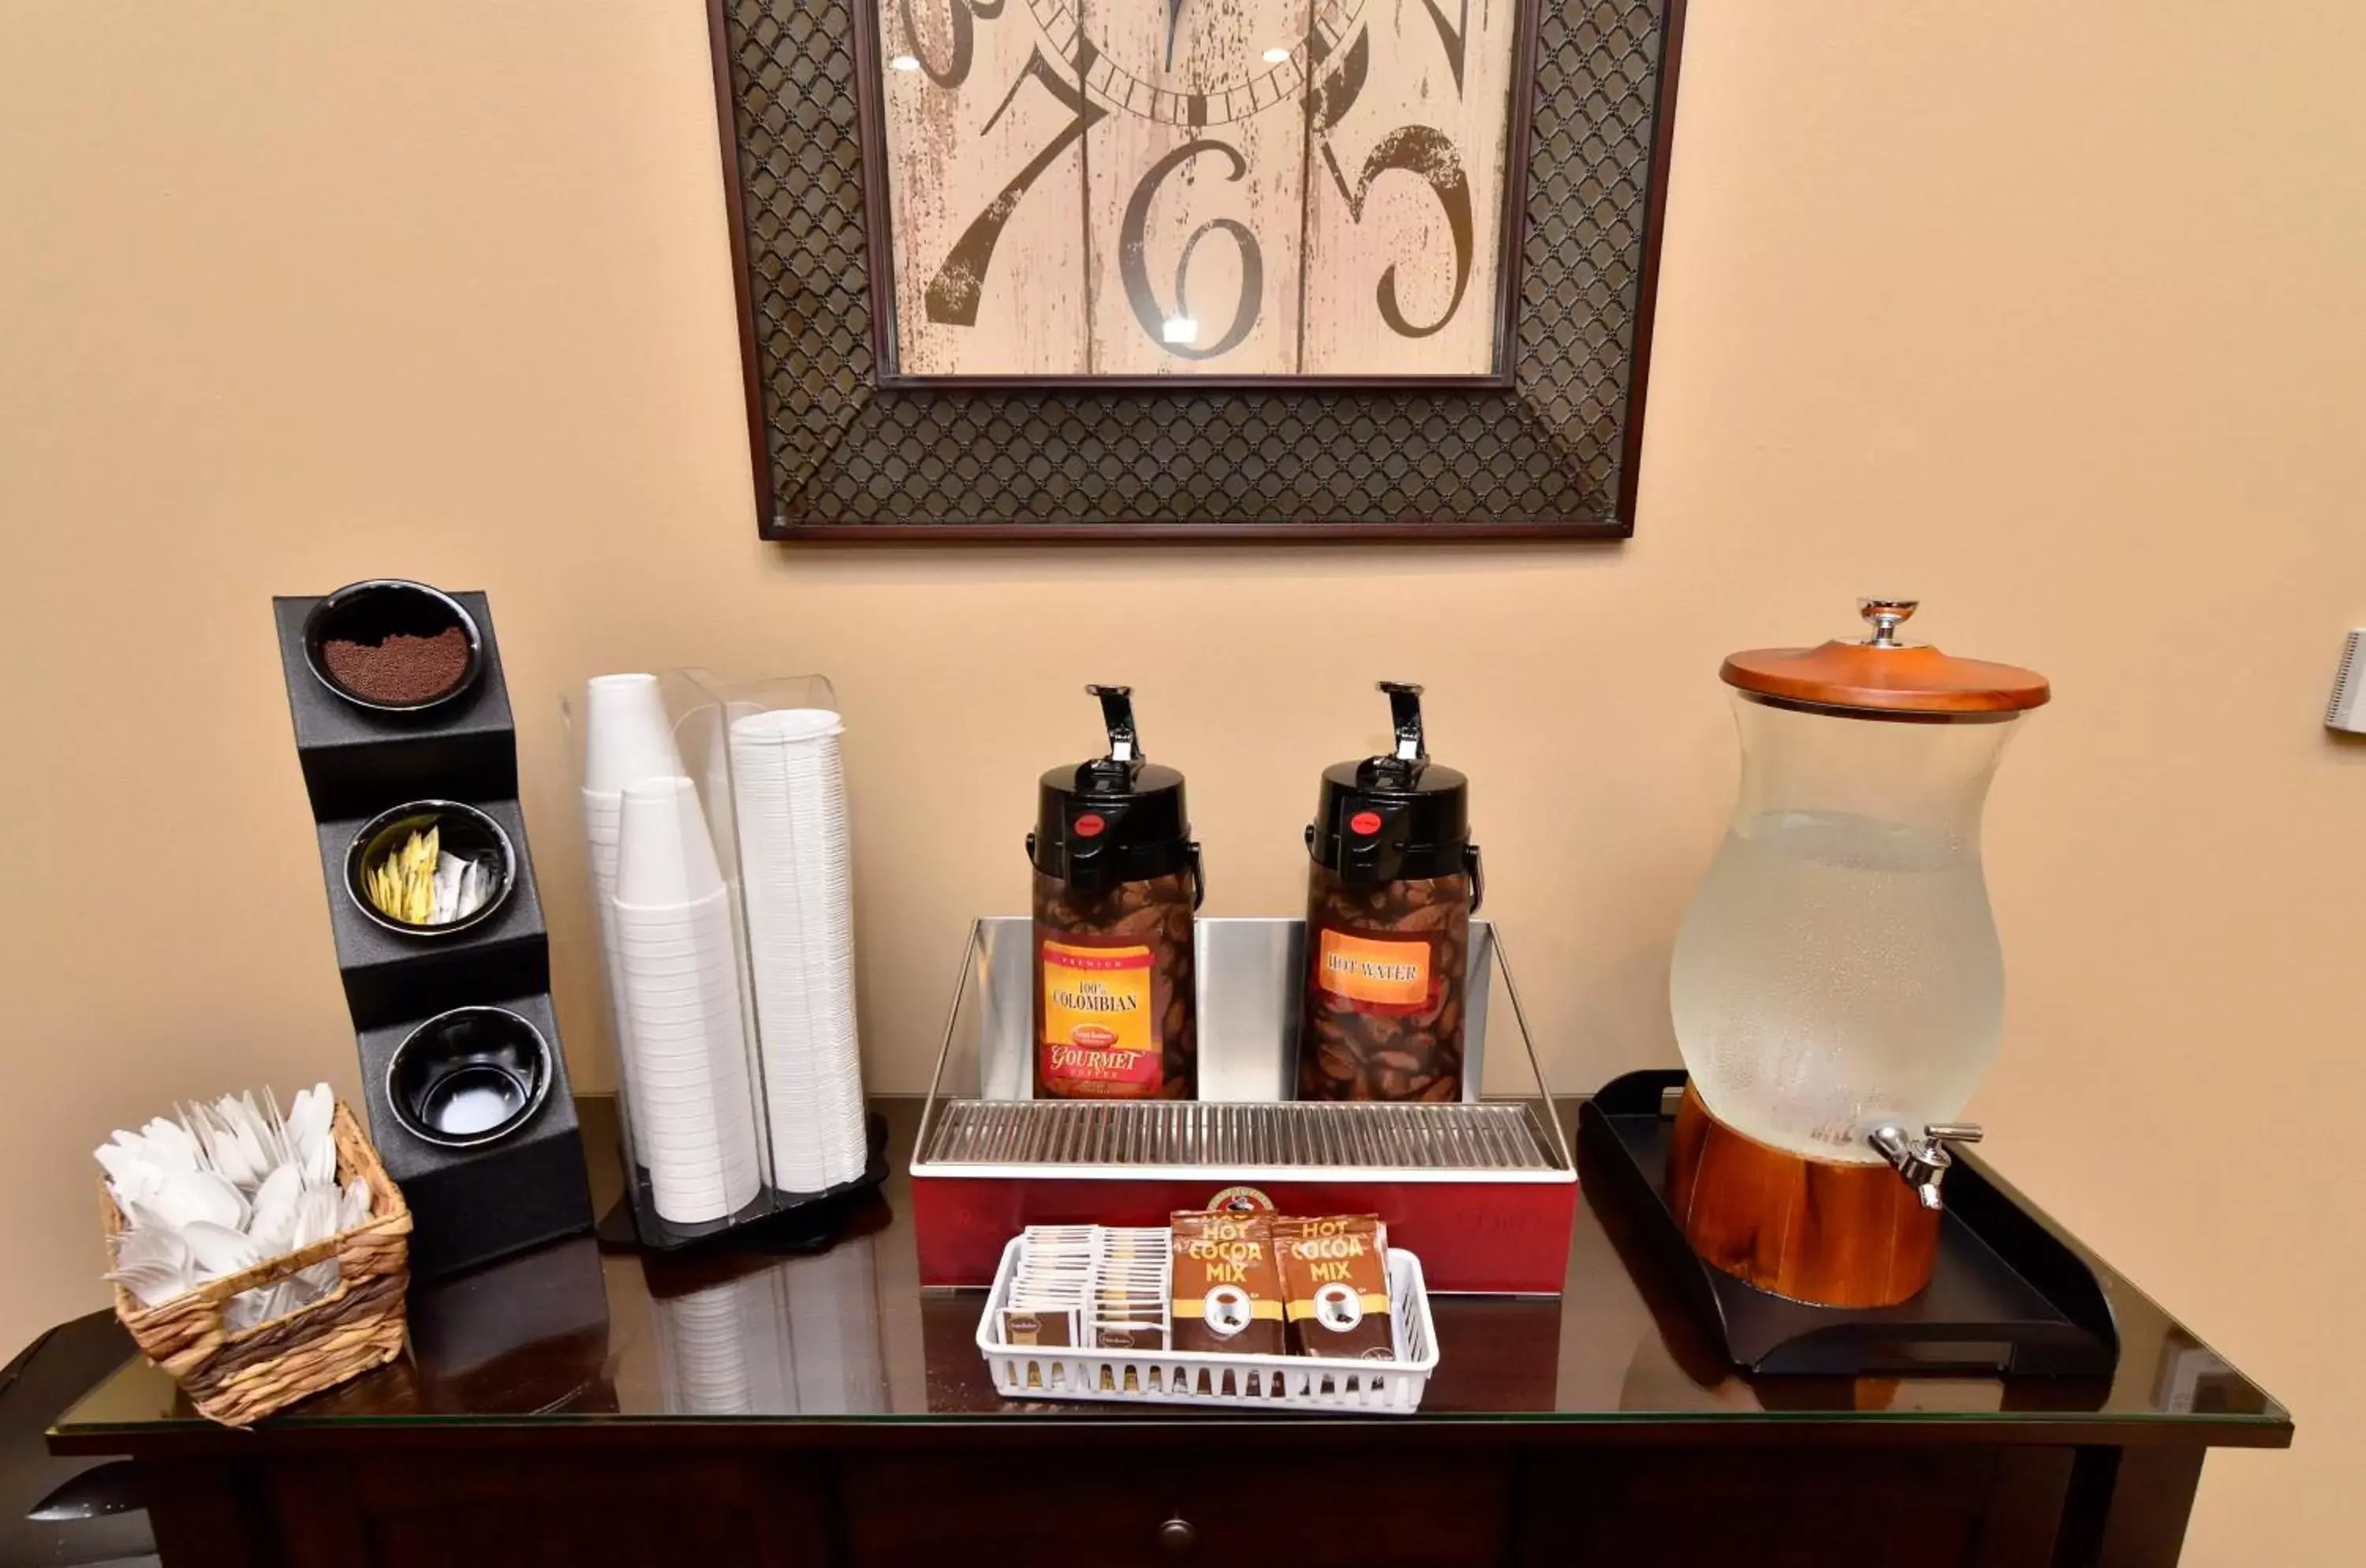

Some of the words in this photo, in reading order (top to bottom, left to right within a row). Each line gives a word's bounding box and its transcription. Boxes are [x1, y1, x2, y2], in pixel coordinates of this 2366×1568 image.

[925, 42, 1109, 327] 7
[1119, 140, 1263, 360] 6
[1299, 21, 1474, 338] 5
[1328, 953, 1357, 973] HOT
[1362, 961, 1416, 980] WATER
[1052, 991, 1136, 1012] COLOMBIAN
[1050, 1045, 1143, 1071] GOURMET
[1203, 1222, 1248, 1240] HOT
[1302, 1220, 1349, 1238] HOT
[1189, 1239, 1263, 1260] COCOA
[1290, 1235, 1364, 1260] COCOA
[1206, 1262, 1247, 1283] MIX
[1309, 1260, 1353, 1282] MIX
